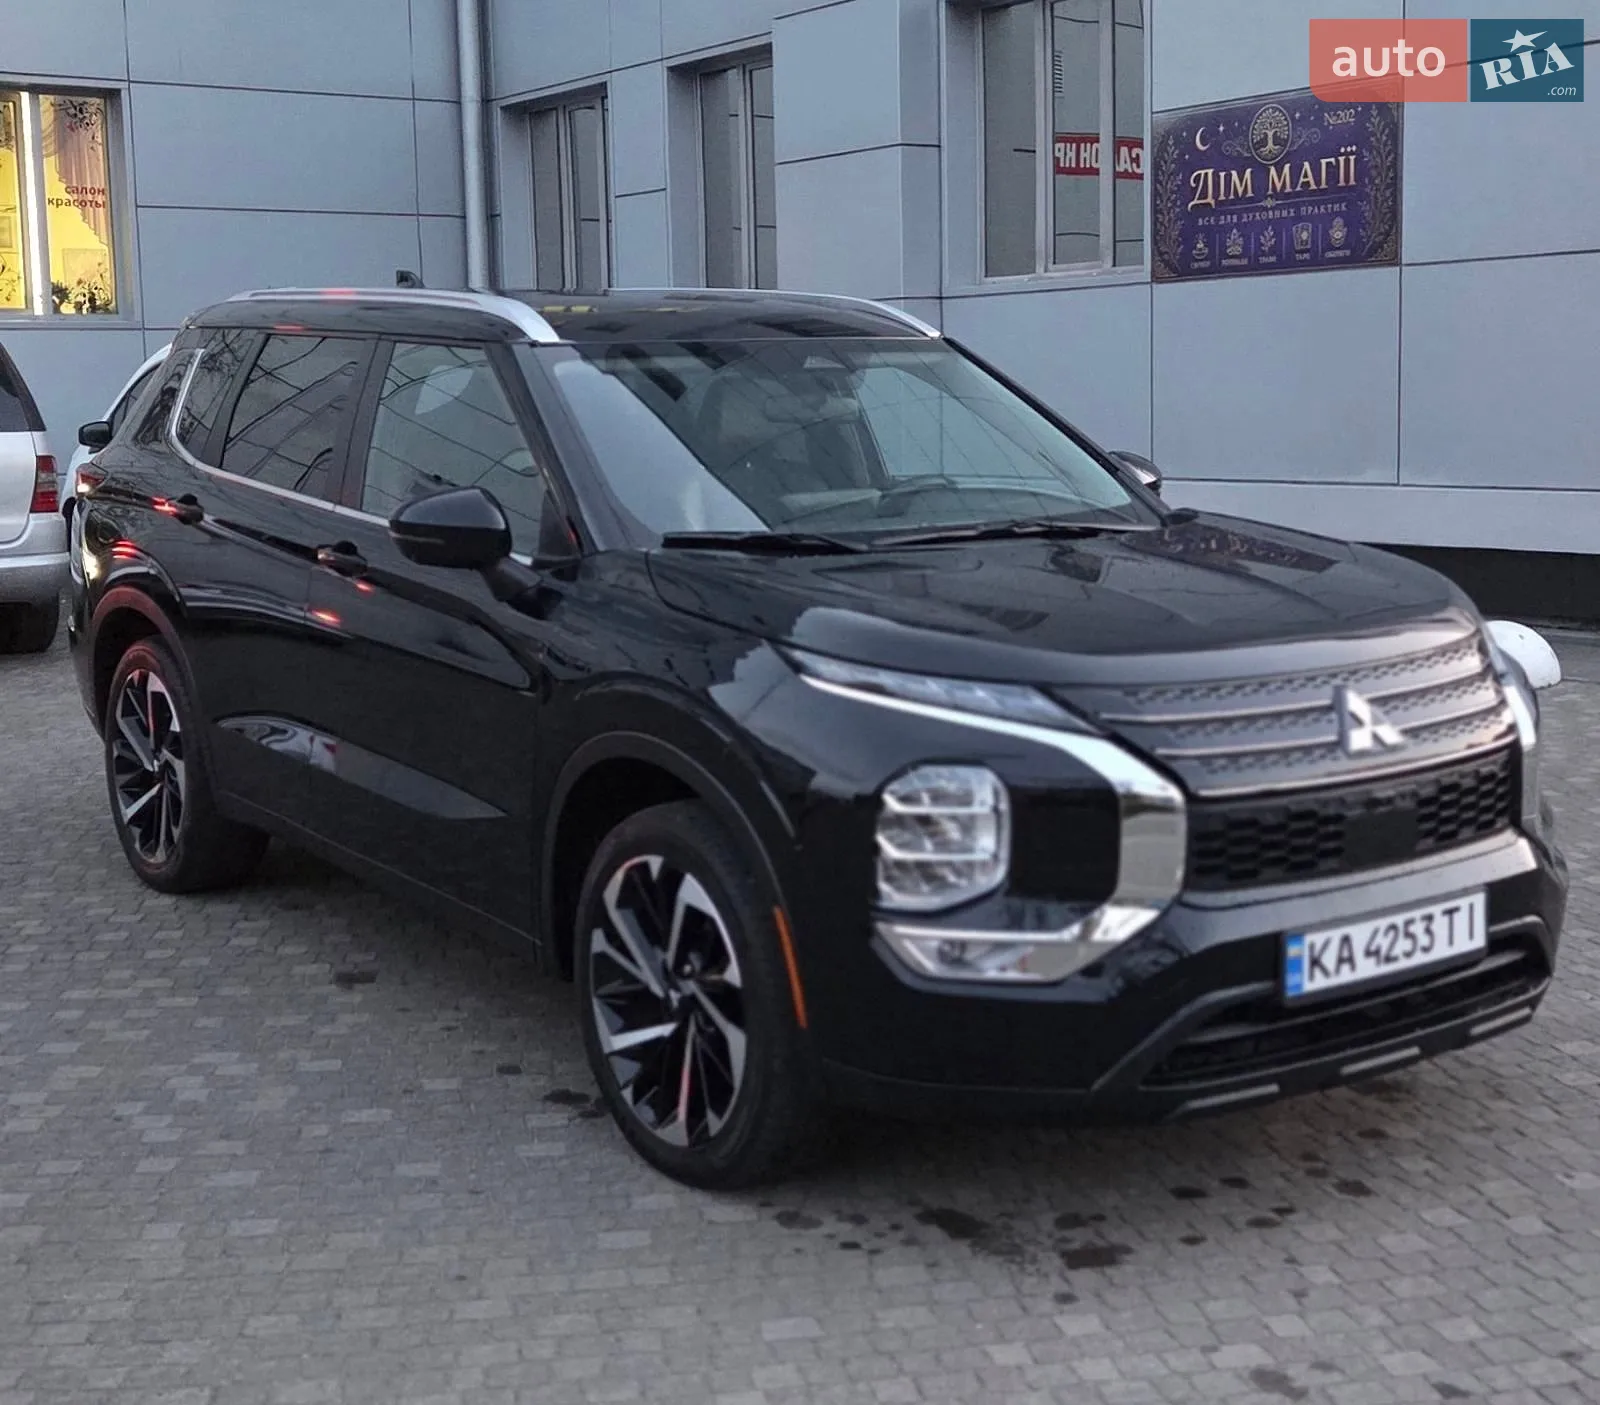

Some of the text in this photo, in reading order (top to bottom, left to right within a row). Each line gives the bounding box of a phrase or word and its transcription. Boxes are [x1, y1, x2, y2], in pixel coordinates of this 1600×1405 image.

[1324, 109, 1355, 126] №202
[1187, 146, 1357, 212] ДІМ МАГІЇ
[64, 186, 105, 196] салон
[47, 198, 106, 208] красоты
[1198, 202, 1347, 226] ВСЕ ДЛЯ ДУХОВНИХ ПРАКТИК
[1308, 902, 1475, 983] KA 4253 TI
